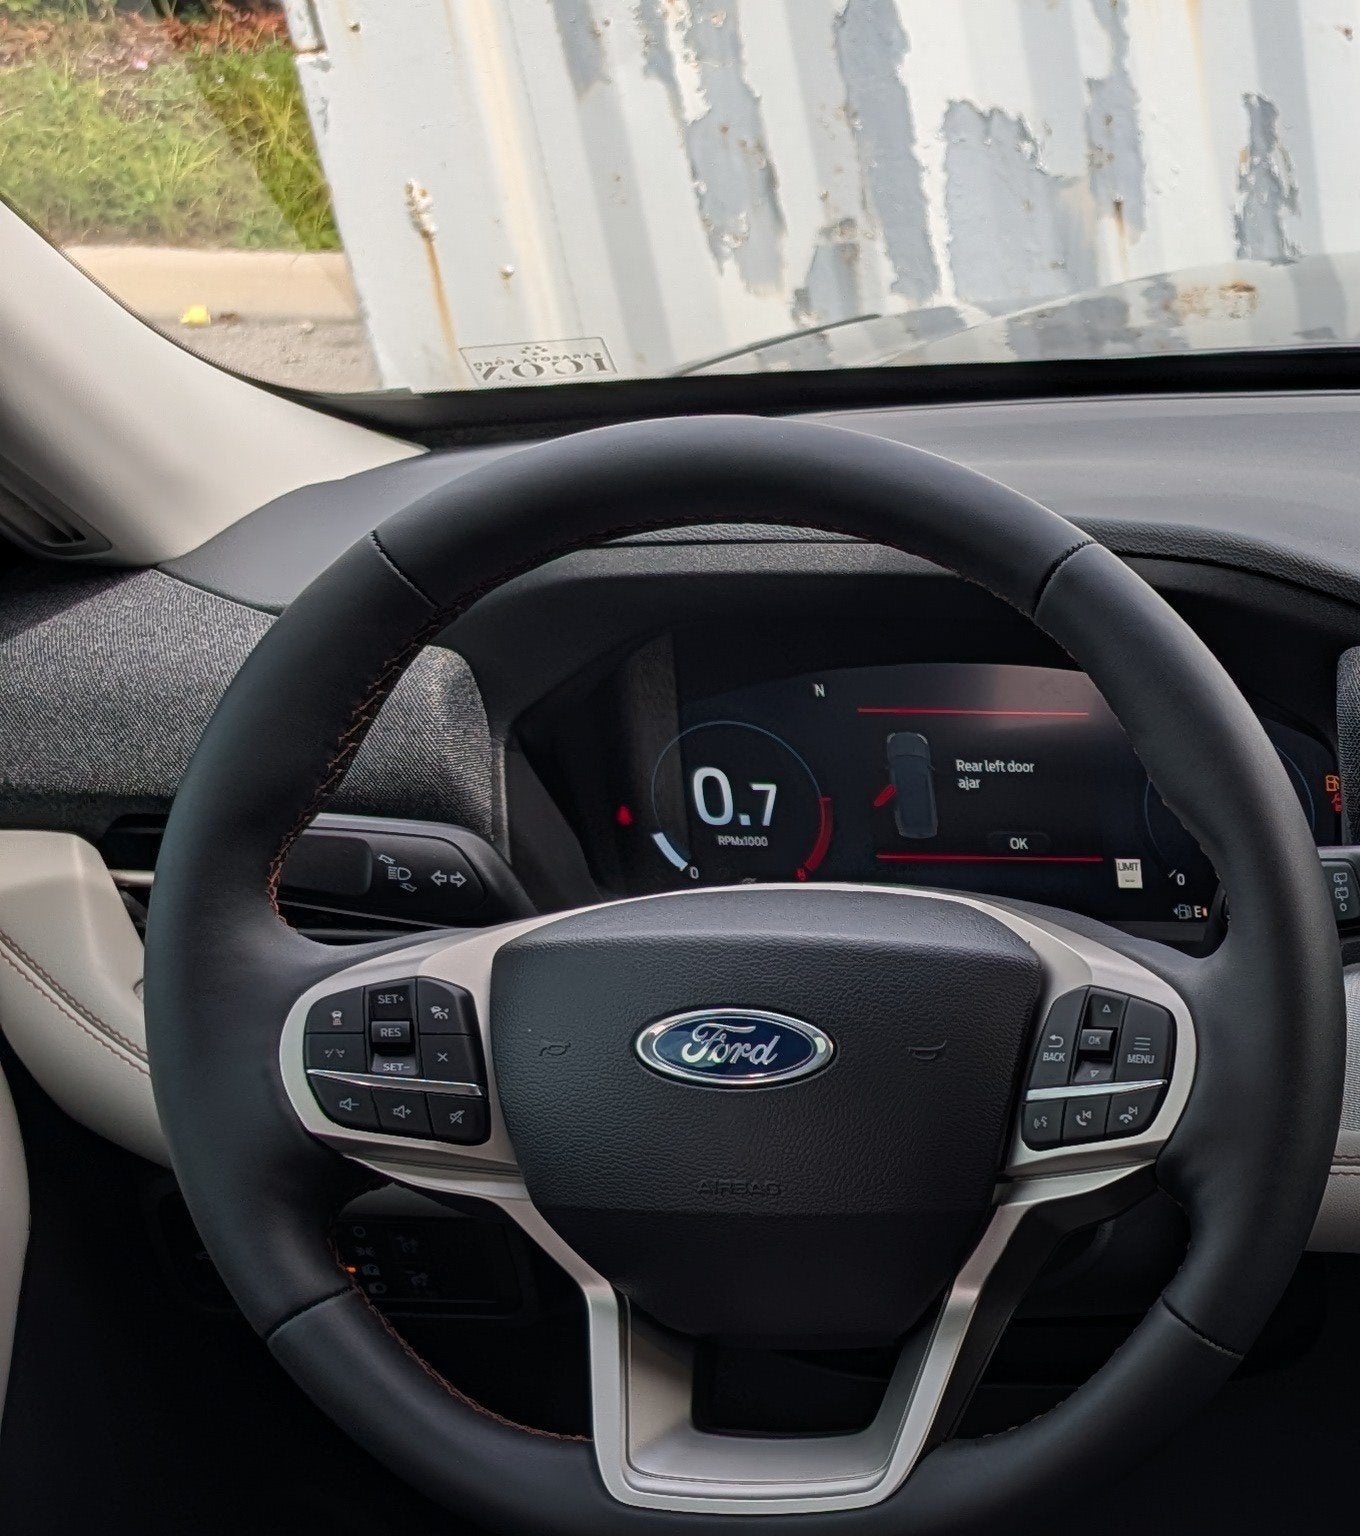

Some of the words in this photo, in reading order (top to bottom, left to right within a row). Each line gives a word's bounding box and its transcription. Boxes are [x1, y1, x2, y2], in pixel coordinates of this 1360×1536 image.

[813, 683, 826, 698] N
[955, 758, 982, 774] Rear
[984, 759, 1005, 774] left
[1007, 760, 1035, 774] door
[957, 776, 981, 792] ajar
[692, 766, 778, 828] 0.7
[717, 835, 769, 848] RPMx1000
[1009, 837, 1029, 851] OK
[688, 866, 700, 880] 0
[1116, 861, 1140, 873] LIMIT
[1175, 872, 1186, 887] 0
[1193, 904, 1203, 919] E
[377, 993, 405, 1005] SET+
[379, 1026, 402, 1039] RES
[681, 1022, 782, 1067] Ford
[1087, 1036, 1102, 1046] OK
[1042, 1052, 1066, 1063] BACK
[1126, 1053, 1155, 1065] MENU
[382, 1062, 411, 1073] SET-
[698, 1178, 783, 1197] AIRBAG
